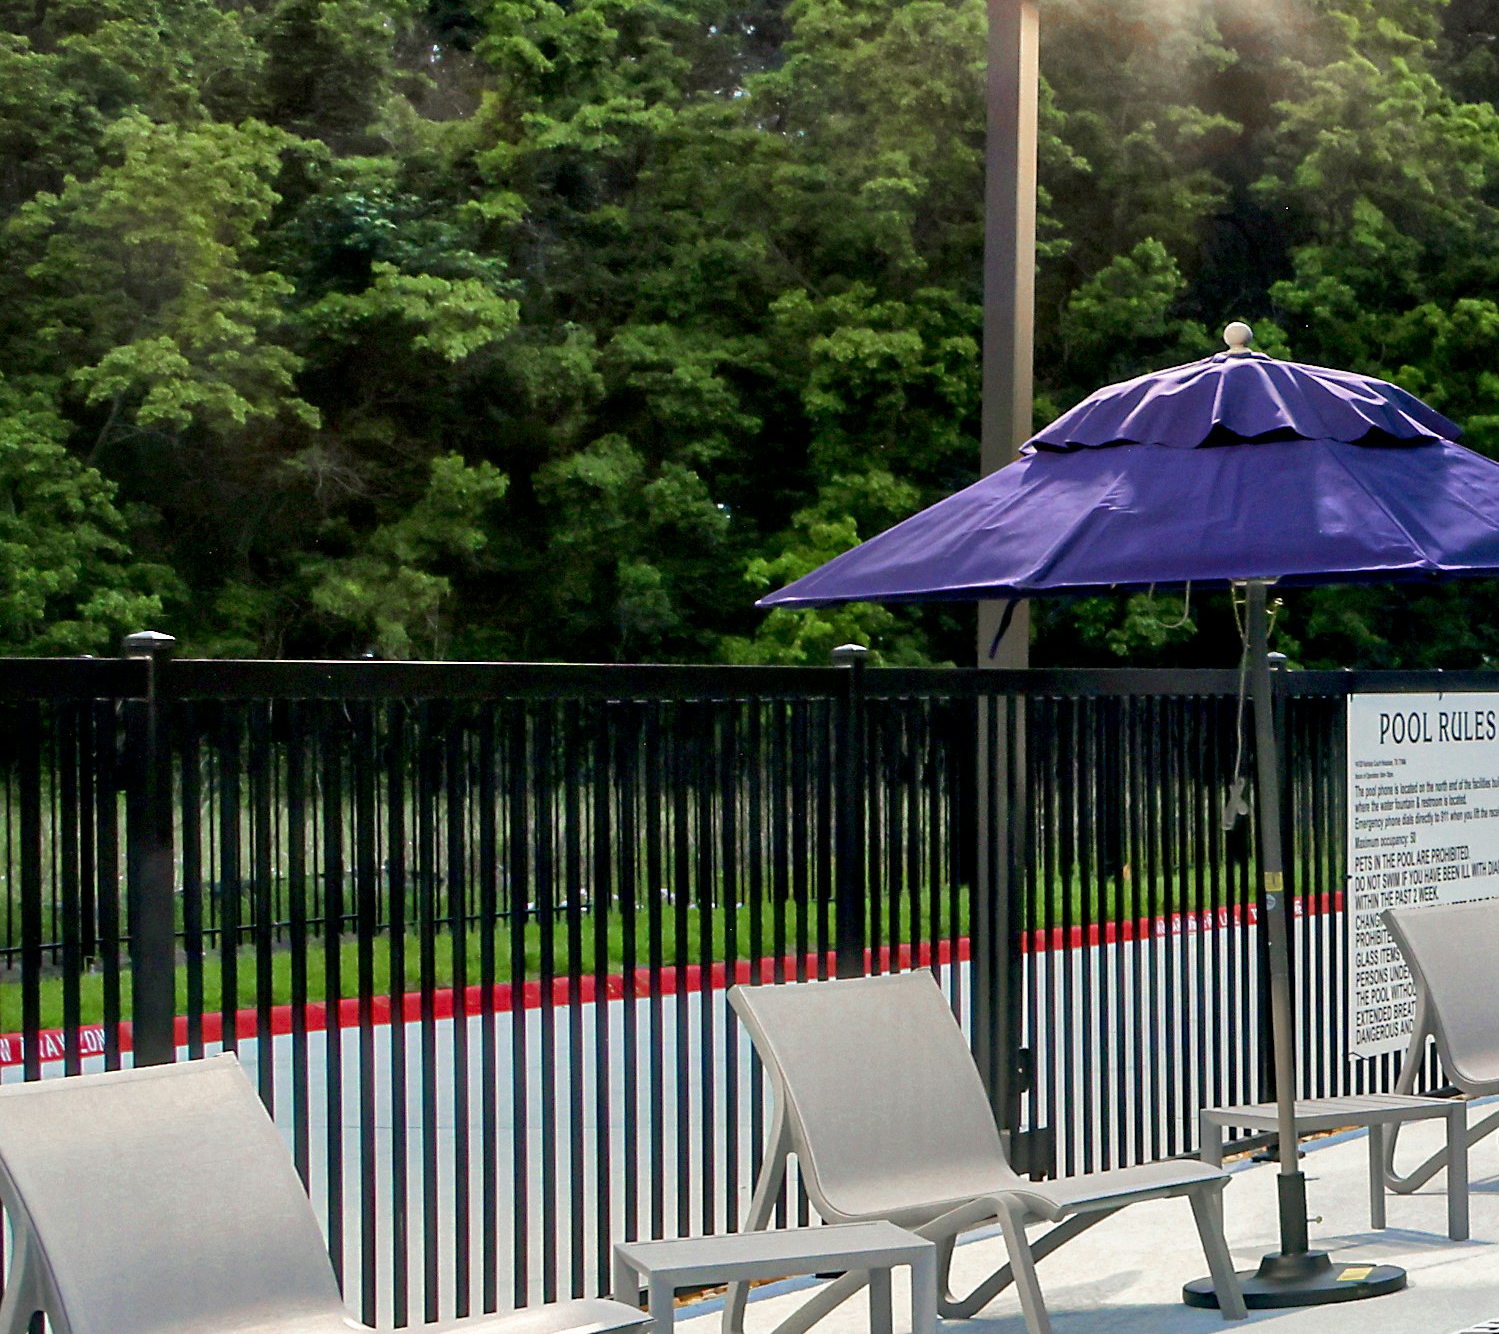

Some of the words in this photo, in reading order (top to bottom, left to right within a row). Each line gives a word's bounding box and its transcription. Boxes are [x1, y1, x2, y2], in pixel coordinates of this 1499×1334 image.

[1380, 712, 1432, 744] POOL
[1439, 710, 1496, 742] RULES
[1355, 785, 1364, 797] The
[1365, 784, 1376, 798] pool
[1377, 784, 1393, 798] phone
[1394, 785, 1399, 796] is
[1400, 783, 1418, 795] located
[1426, 781, 1434, 793] the
[1355, 801, 1370, 813] where
[1371, 800, 1379, 812] the
[1380, 800, 1393, 811] water
[1394, 798, 1415, 810] fountain
[1421, 797, 1442, 807] restroom
[1354, 816, 1384, 831] Emergency
[1384, 815, 1401, 830] phone
[1402, 813, 1414, 826] dials
[1415, 811, 1434, 826] directly
[1440, 810, 1449, 823] 911
[1450, 810, 1463, 821] when
[1464, 810, 1473, 823] you
[1480, 807, 1488, 818] the
[1355, 836, 1379, 849] Maximum
[1355, 856, 1372, 873] PETS
[1374, 855, 1381, 870] IN
[1382, 853, 1395, 869] THE
[1397, 851, 1415, 867] POOL
[1416, 849, 1430, 865] ARE
[1355, 876, 1365, 892] DO
[1367, 874, 1381, 890] NOT
[1382, 872, 1400, 888] SWIM
[1401, 871, 1408, 887] IF
[1409, 869, 1423, 885] YOU
[1424, 867, 1442, 883] HAVE
[1443, 865, 1460, 881] BEEN
[1461, 863, 1470, 879] ILL
[1472, 862, 1486, 877] WITH
[1355, 893, 1379, 911] WITHIN
[1380, 891, 1394, 907] THE
[1395, 889, 1412, 906] PAST
[1413, 888, 1417, 903] 2
[1356, 913, 1380, 930] CHANG
[1356, 929, 1392, 948] PROHIBITE
[1356, 950, 1379, 968] GLASS
[1380, 946, 1400, 964] ITEMS
[1356, 968, 1388, 988] PERSONS
[1389, 964, 1409, 982] UNDE
[1356, 990, 1370, 1007] THE
[1371, 987, 1390, 1004] POOL
[1391, 982, 1416, 1000] WITHO
[1356, 1005, 1392, 1027] EXTENDED
[1393, 1000, 1416, 1020] BREAT
[1356, 1022, 1398, 1046] DANGEROUS
